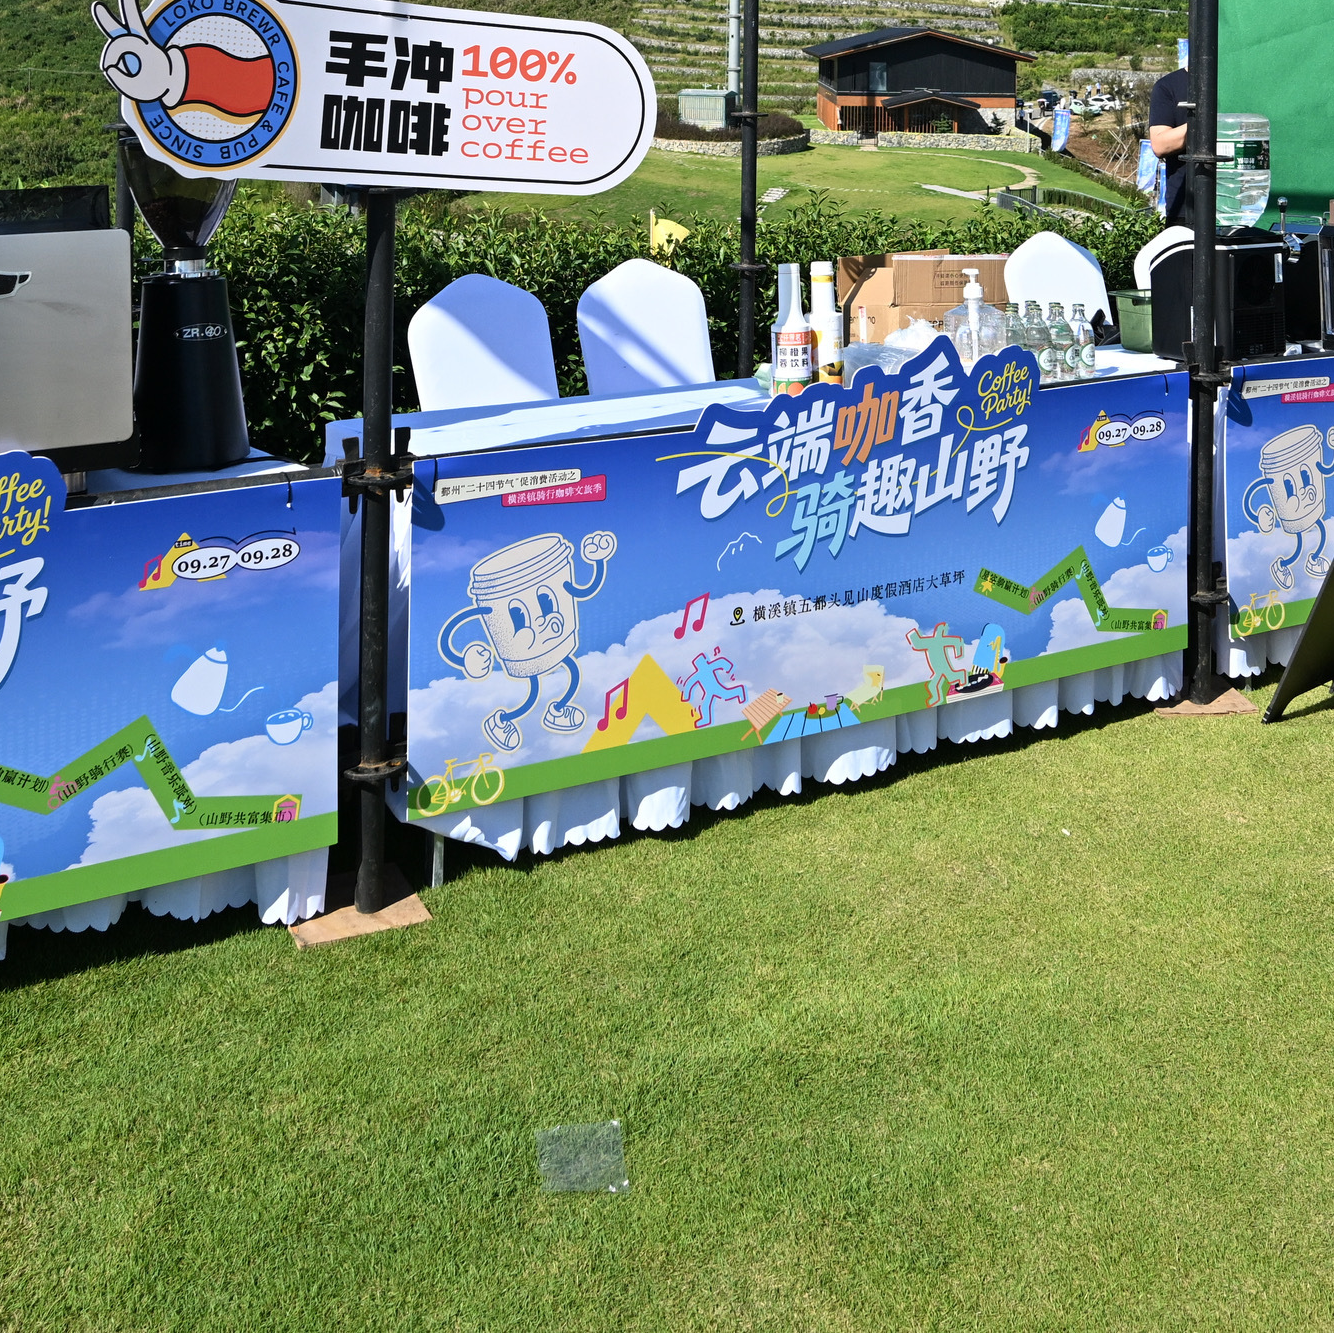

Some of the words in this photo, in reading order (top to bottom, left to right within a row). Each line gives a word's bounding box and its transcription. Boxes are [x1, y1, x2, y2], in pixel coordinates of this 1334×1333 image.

[325, 31, 455, 93] 手冲
[462, 44, 577, 85] 100%
[271, 61, 289, 115] CAFE
[462, 85, 548, 111] pour
[150, 115, 204, 158] SINCE
[260, 120, 273, 132] &
[320, 94, 451, 156] 咖啡
[463, 113, 547, 136] over
[220, 134, 258, 159] PUB
[460, 137, 589, 164] coffee
[978, 362, 1031, 397] Coffee
[980, 378, 1033, 422] Party!
[676, 352, 961, 520] 云端咖香
[1098, 425, 1128, 442] 09.27
[1132, 419, 1164, 437] 09.28
[506, 481, 603, 506] 横溪镇骑行咖啡文旅季
[775, 423, 1031, 574] 骑趣山野
[177, 555, 230, 574] 09.27
[240, 544, 293, 565] 09.28
[752, 569, 966, 623] 横溪镇五都头见山度假酒店大草坪
